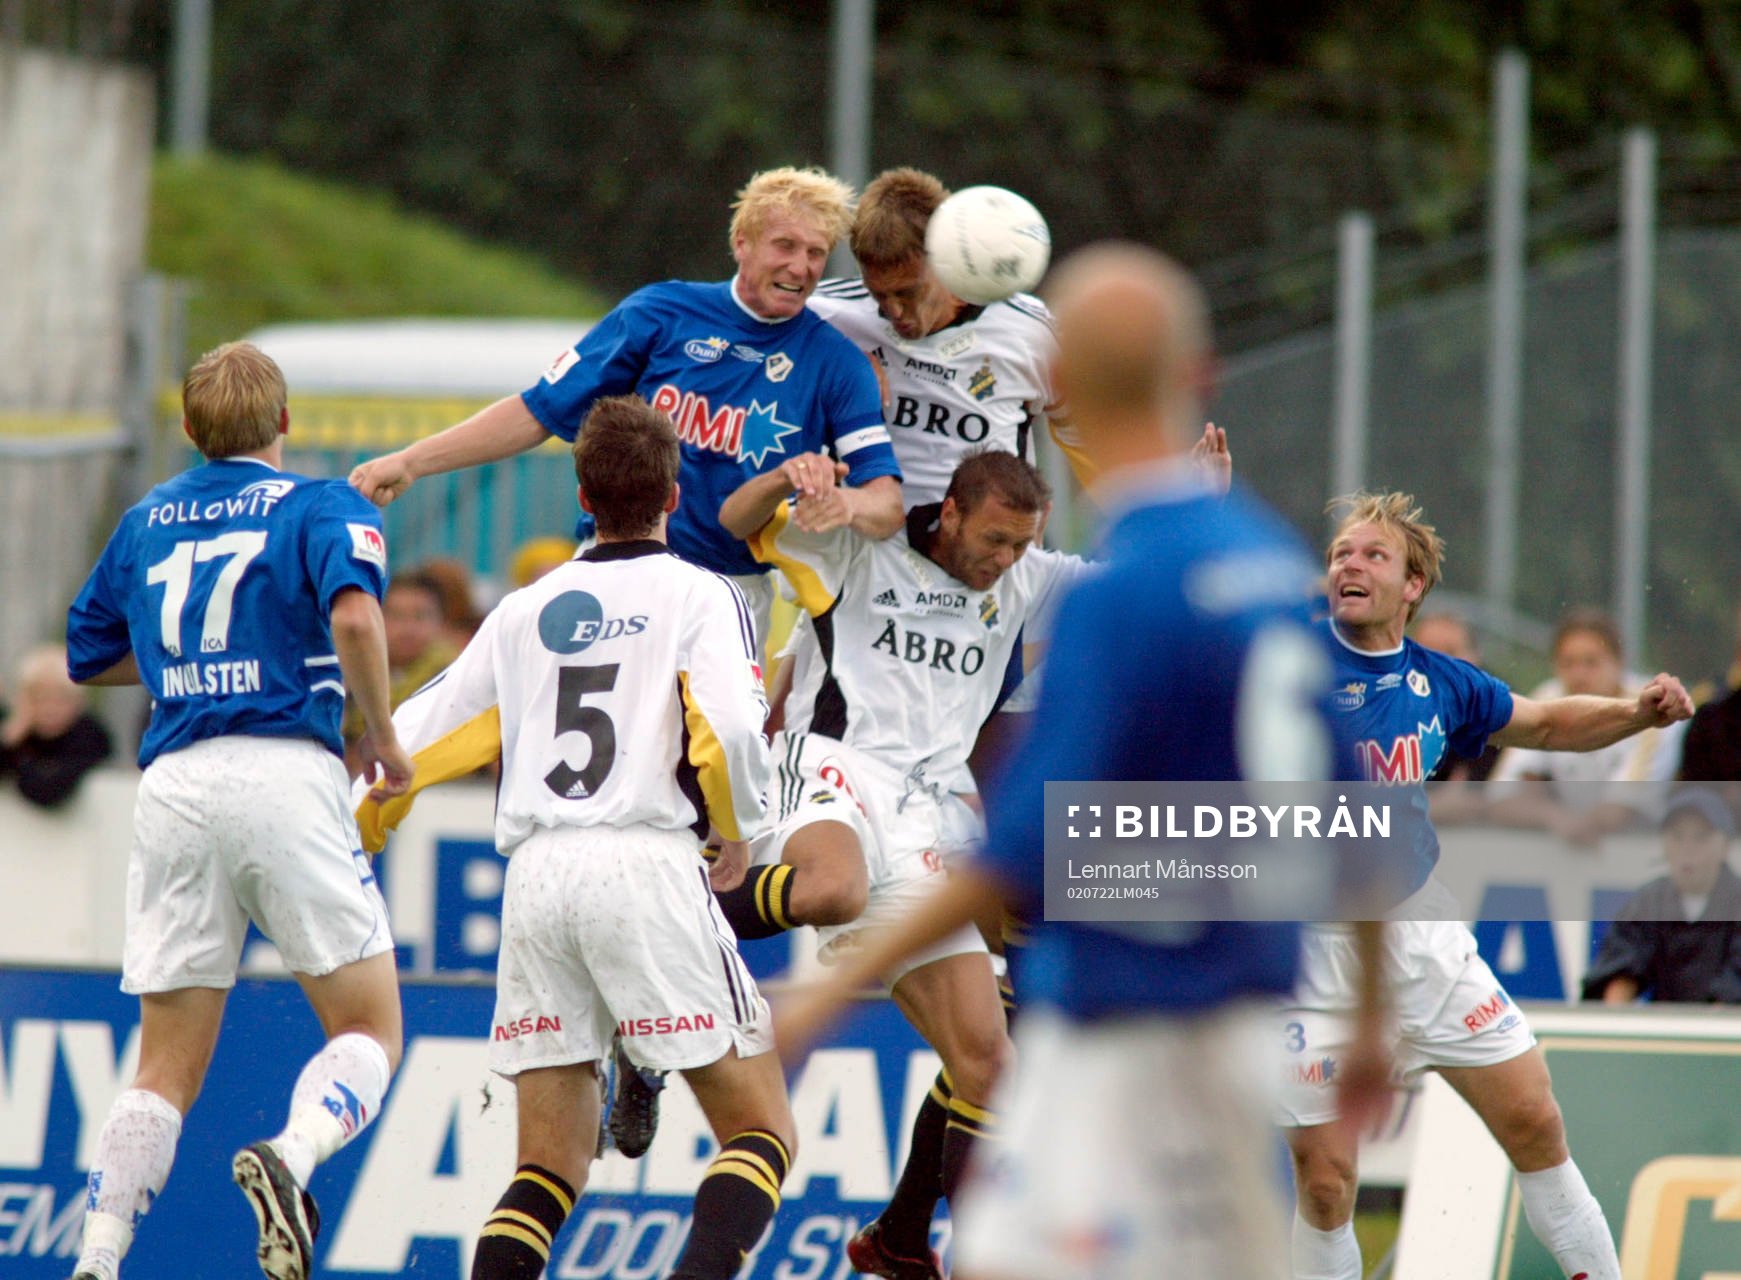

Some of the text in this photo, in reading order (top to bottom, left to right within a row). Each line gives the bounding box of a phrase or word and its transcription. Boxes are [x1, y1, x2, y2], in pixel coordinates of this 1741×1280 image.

[690, 343, 719, 359] Duni
[653, 384, 747, 456] RIMI
[881, 395, 990, 443] BRO
[146, 530, 269, 658] 17
[203, 638, 225, 651] ICA
[569, 615, 649, 643] EDS
[872, 618, 985, 676] ÅBRO
[543, 662, 621, 800] 5
[495, 1015, 562, 1042] NSSAN
[619, 1013, 715, 1037] NISSAN
[1284, 1022, 1307, 1054] 3
